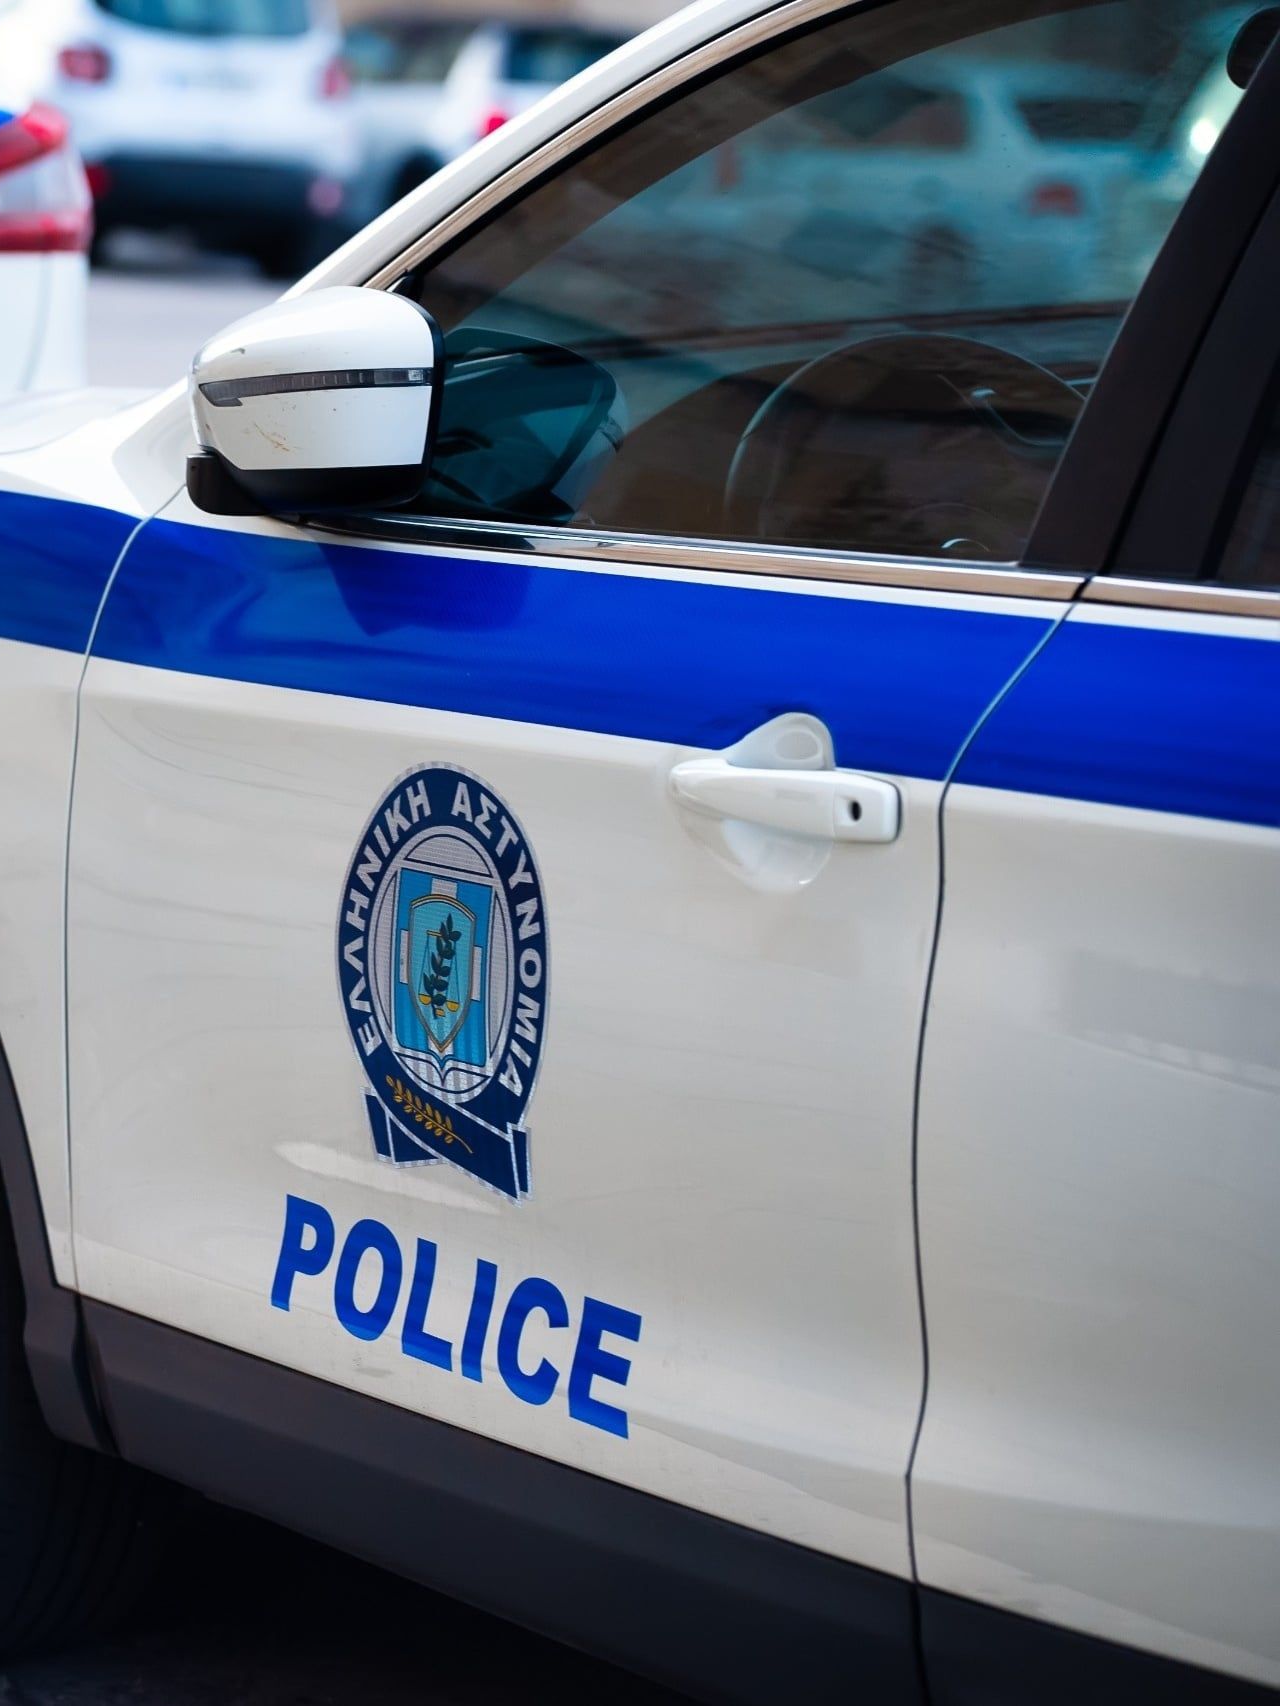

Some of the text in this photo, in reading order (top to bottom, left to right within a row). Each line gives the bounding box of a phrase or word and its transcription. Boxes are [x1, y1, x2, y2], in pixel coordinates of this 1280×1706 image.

[342, 780, 542, 1097] ΕΛΛΗΝΙΚΗ ΑΣΤΥΝΟΜΙΑ
[271, 1194, 642, 1439] POLICE
